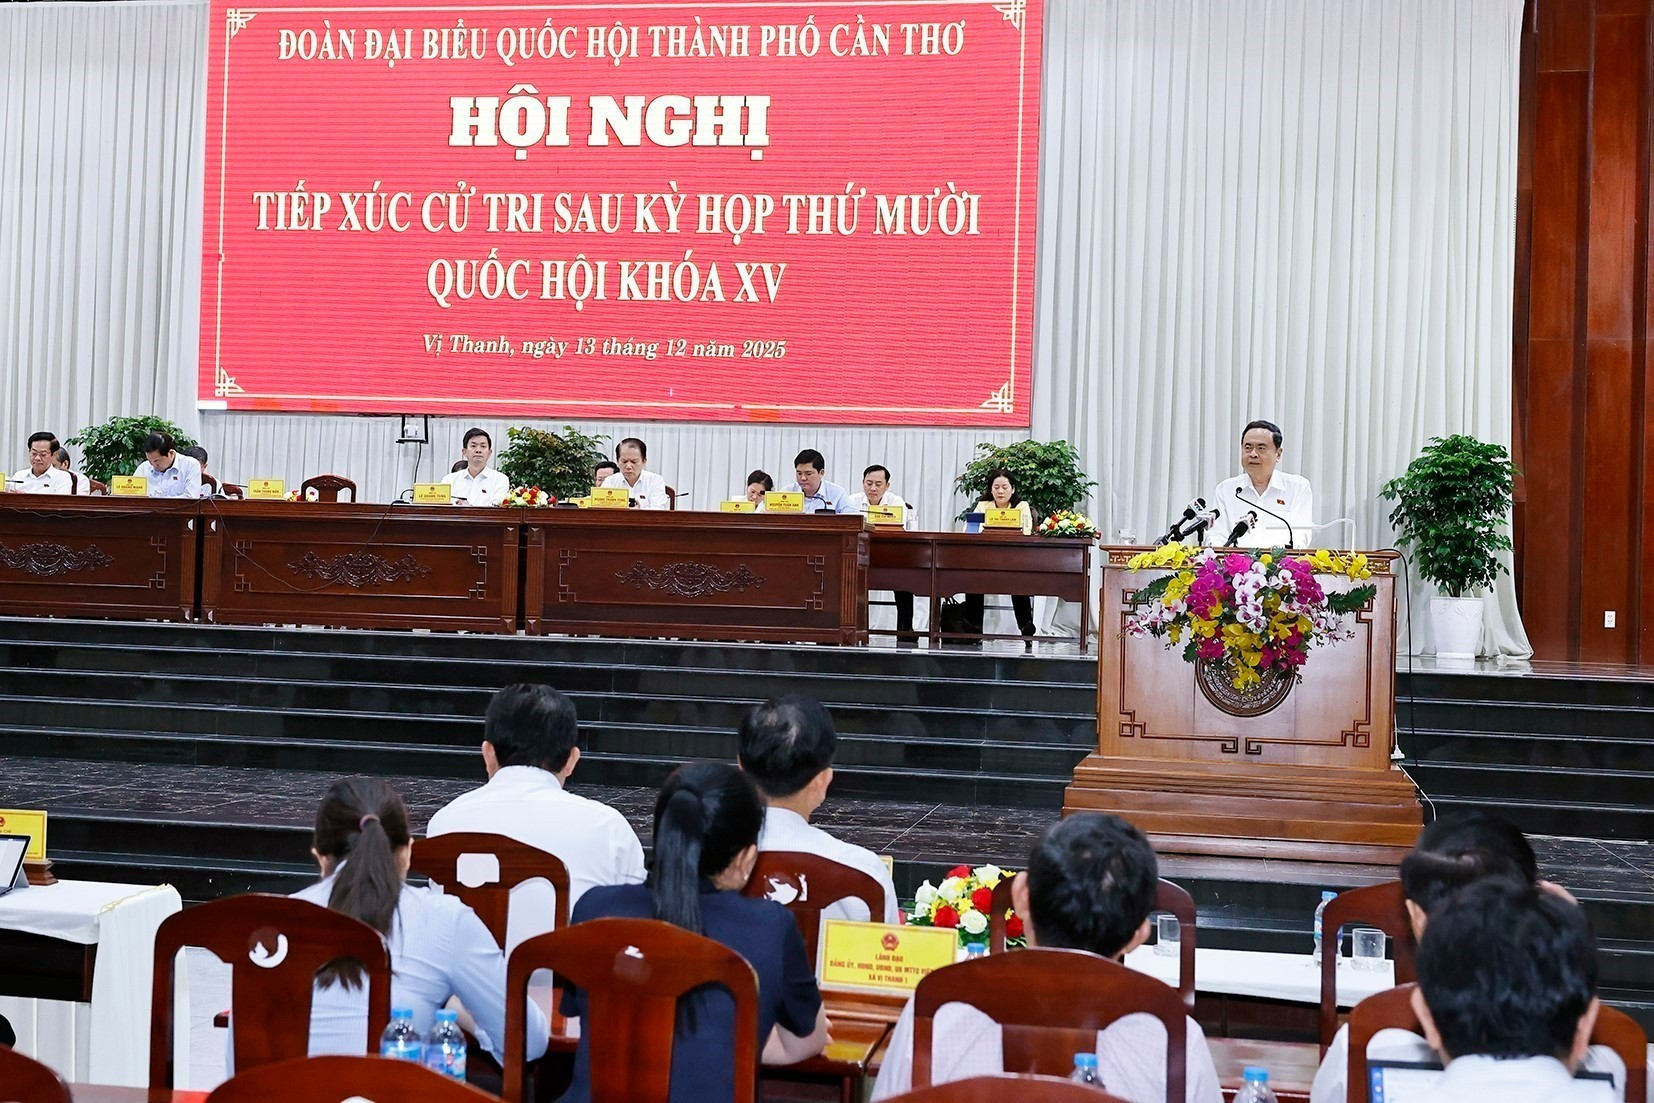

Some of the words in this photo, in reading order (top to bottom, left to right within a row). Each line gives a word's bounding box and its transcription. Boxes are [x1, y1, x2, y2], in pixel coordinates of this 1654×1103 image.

[278, 20, 357, 61] ĐOÀN
[363, 28, 414, 69] ĐẠI
[421, 18, 489, 60] BIỂU
[496, 17, 578, 67] QUỐC
[585, 21, 640, 67] HỘI
[647, 16, 751, 58] THÀNH
[758, 14, 821, 57] PHỐ
[829, 14, 892, 57] CẦN
[900, 19, 966, 56] THƠ
[448, 83, 572, 160] HỘI
[587, 94, 771, 161] NGHỊ
[252, 179, 332, 231] TIẾP
[337, 180, 412, 232] XÚC
[421, 180, 477, 233] CỬ
[483, 193, 545, 233] TRI
[553, 192, 625, 234] SAU
[633, 180, 688, 234] KỲ
[695, 193, 775, 246] HỌP
[782, 181, 867, 236] THỨ
[872, 181, 982, 236] MƯỜI
[427, 248, 531, 308] QUỐC
[539, 253, 609, 312] HỘI
[617, 249, 726, 302] KHÓA
[733, 262, 788, 303] XV
[423, 334, 444, 357] Vị
[449, 334, 515, 357] Thanh,
[521, 336, 569, 359] ngày
[574, 337, 597, 355] 13
[602, 336, 660, 361] tháng
[665, 338, 688, 357] 12
[691, 339, 735, 358] năm
[741, 339, 787, 359] 2025
